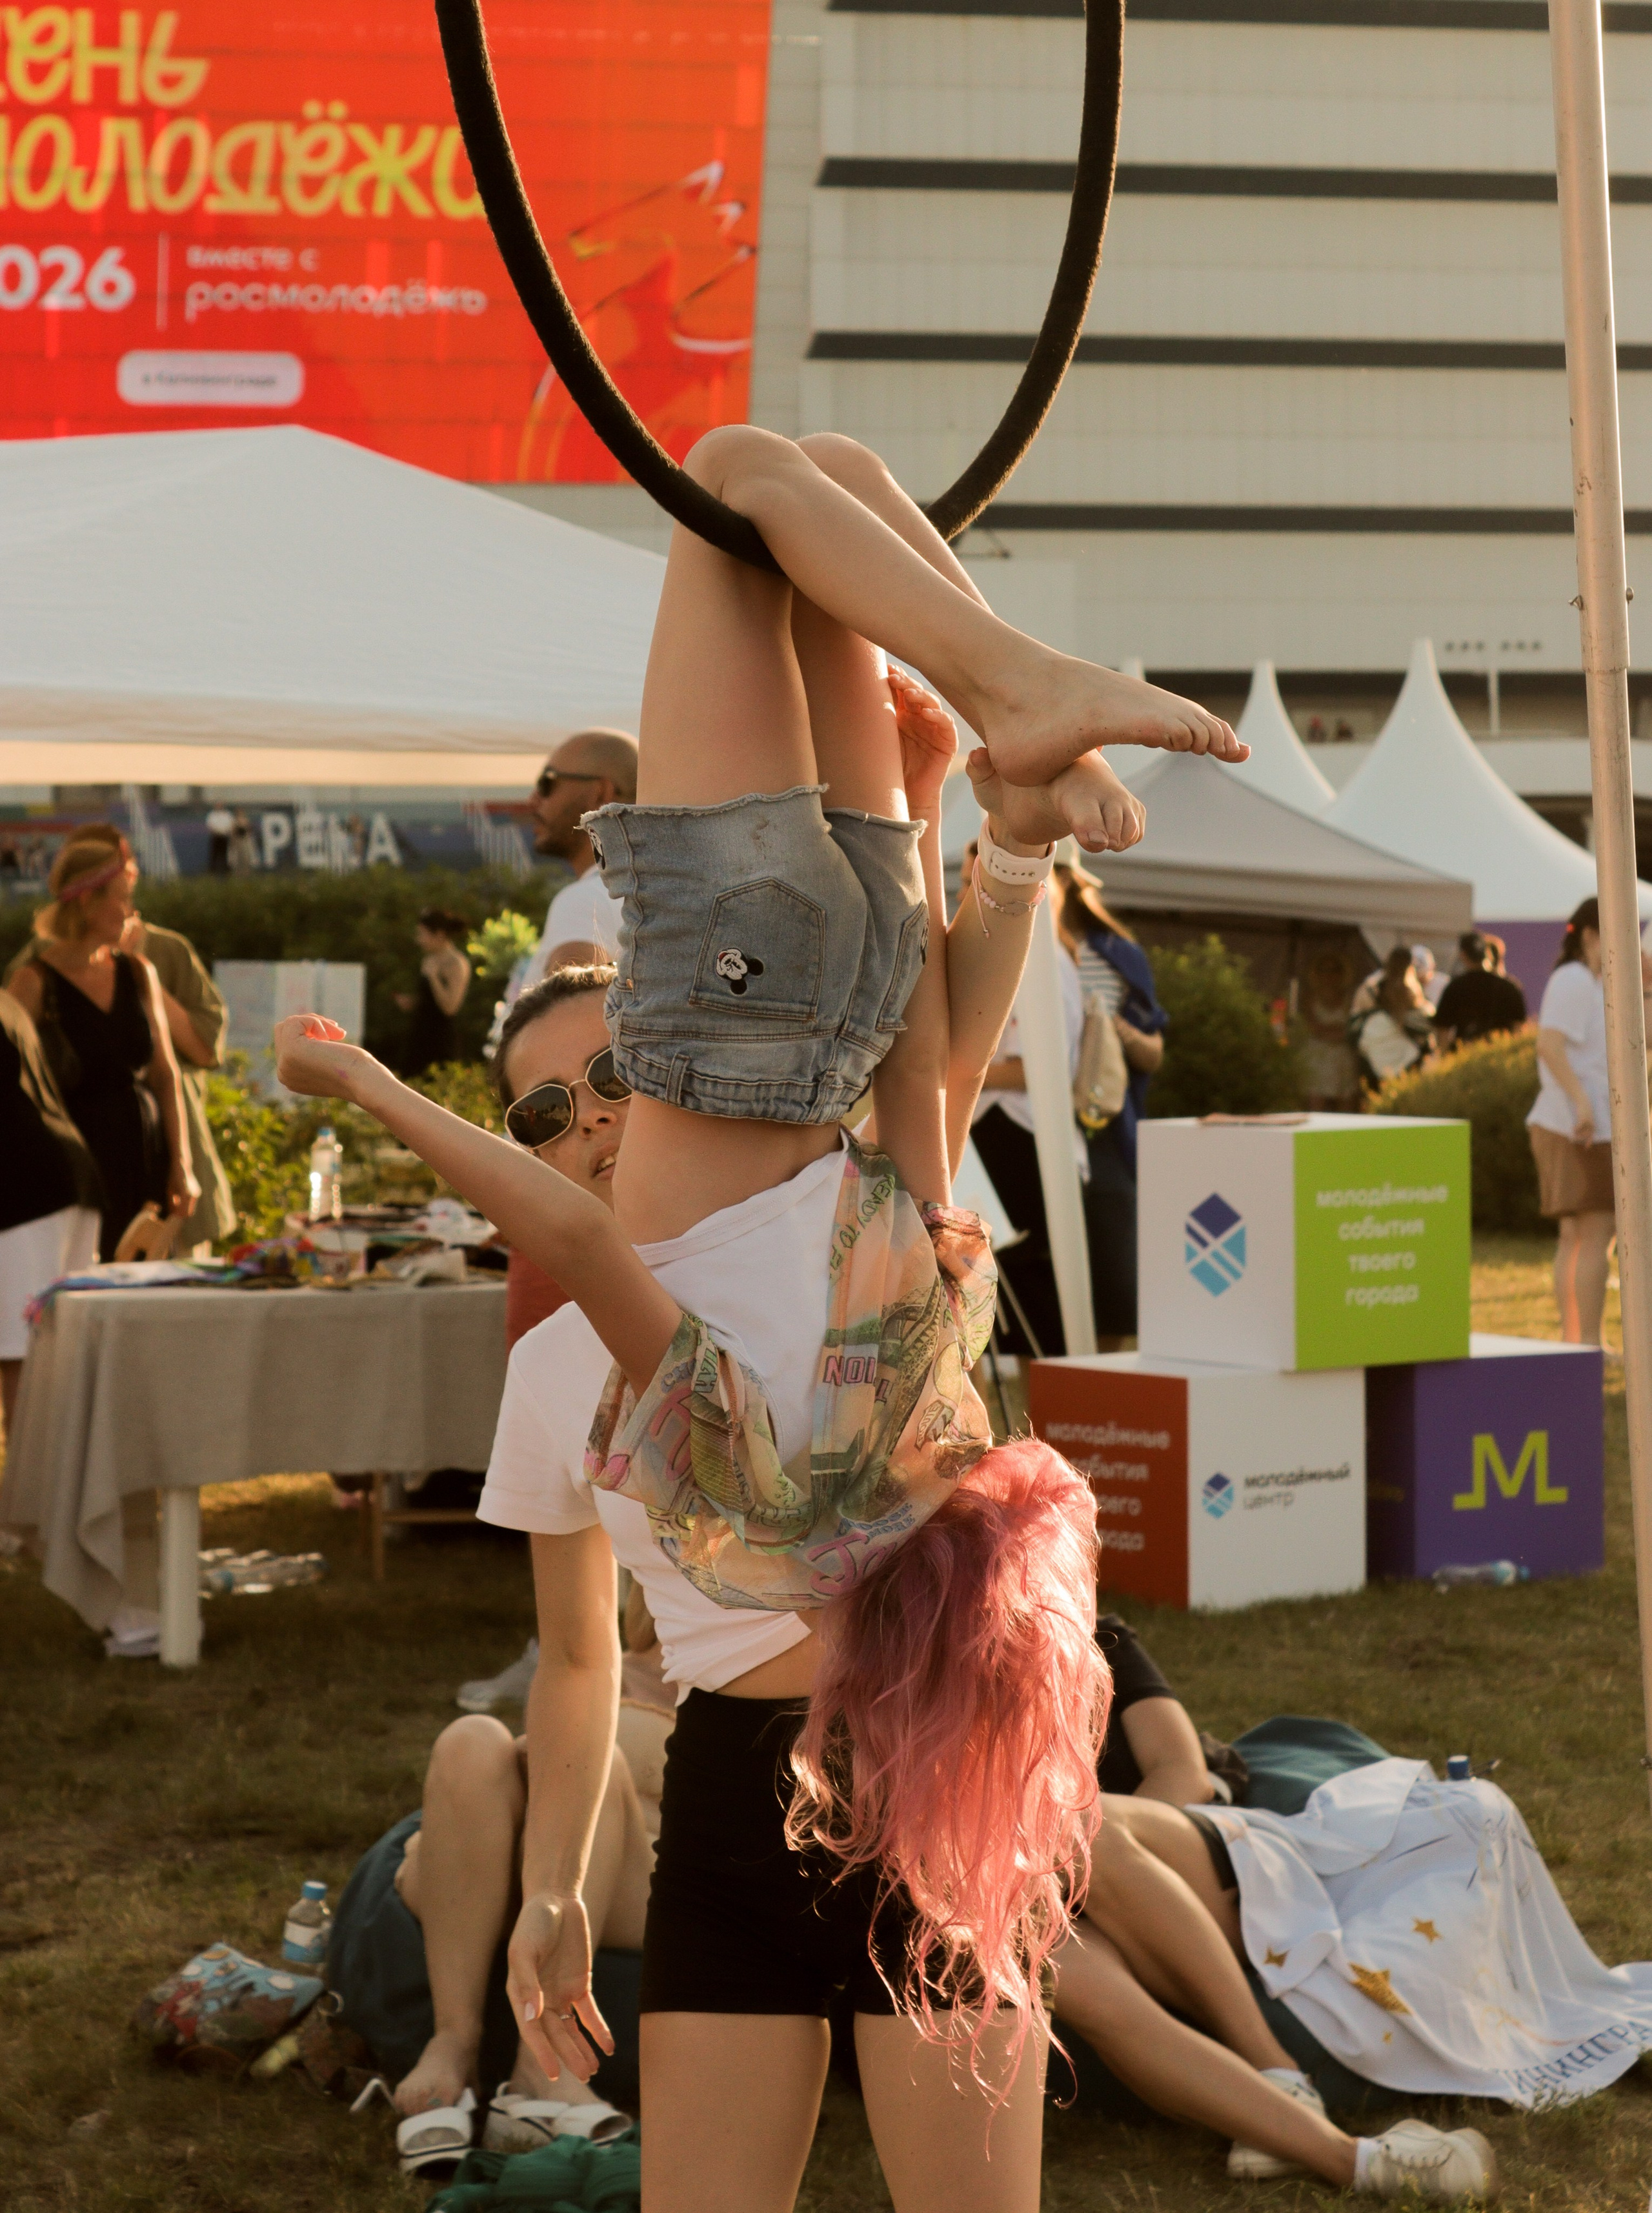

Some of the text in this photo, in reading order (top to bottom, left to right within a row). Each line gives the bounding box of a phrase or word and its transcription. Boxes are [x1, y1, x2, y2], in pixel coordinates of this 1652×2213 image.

[0, 6, 210, 106] ень
[186, 245, 318, 272] вместе с
[1316, 1182, 1447, 1208] молодёжные
[1338, 1215, 1424, 1240] события
[1349, 1251, 1416, 1273] твоего
[1345, 1284, 1419, 1309] города
[823, 1355, 894, 1406] TION
[1045, 1421, 1170, 1450] молодёжные
[1244, 1460, 1351, 1490] молодёжный
[1244, 1490, 1294, 1511] центр
